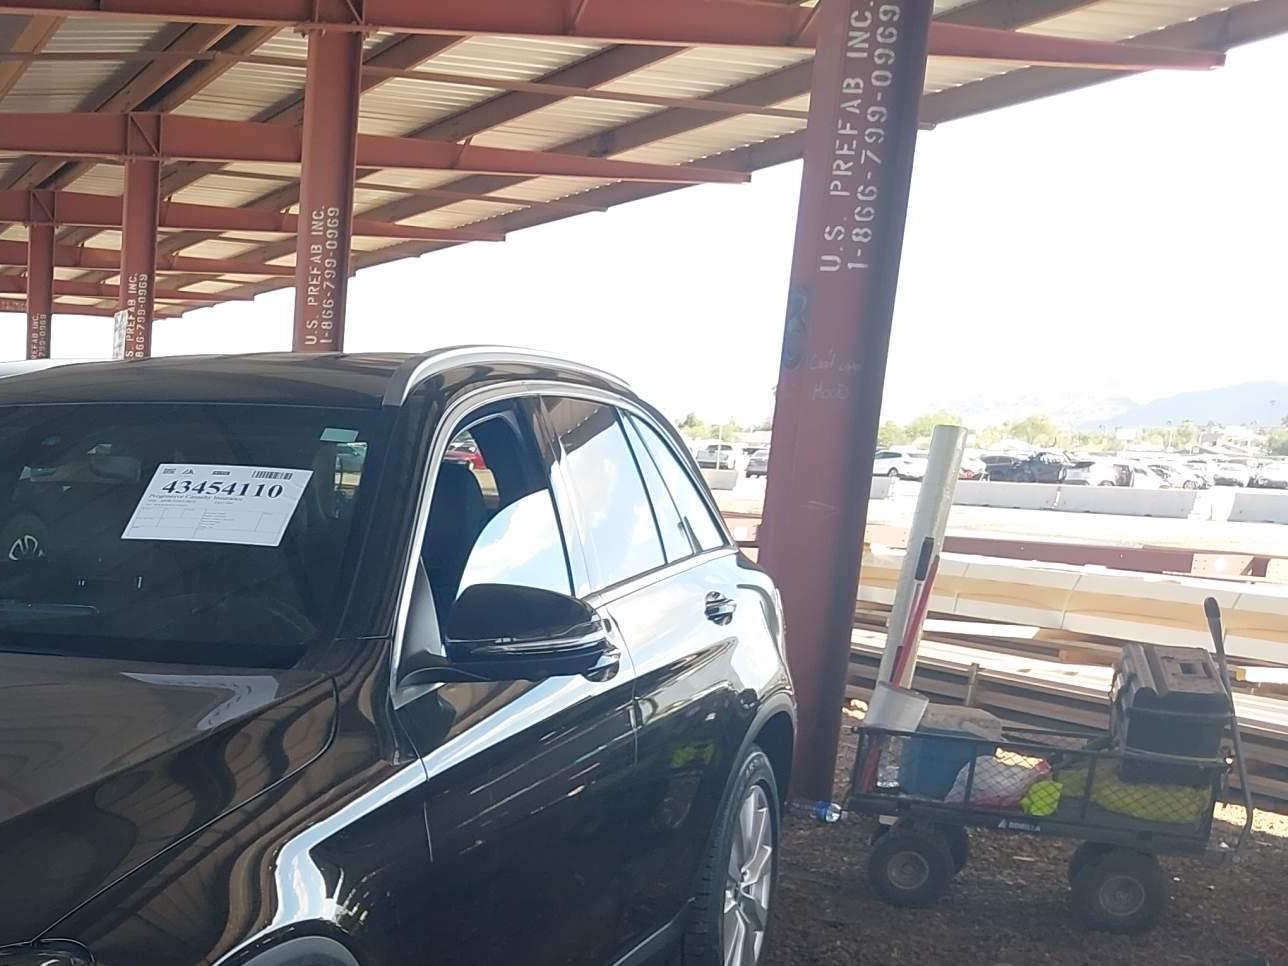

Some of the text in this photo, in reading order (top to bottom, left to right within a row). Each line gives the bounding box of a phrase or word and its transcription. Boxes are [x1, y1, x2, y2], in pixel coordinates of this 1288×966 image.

[819, 0, 874, 272] U.S. PREFAB INC.
[847, 4, 901, 270] 1-866-799-0969
[126, 299, 137, 342] PREFAB
[128, 272, 139, 294] INC.
[304, 205, 325, 345] U.S. PREFAB INC.
[319, 207, 340, 344] 1-866-799-0969
[161, 479, 283, 499] 43454110
